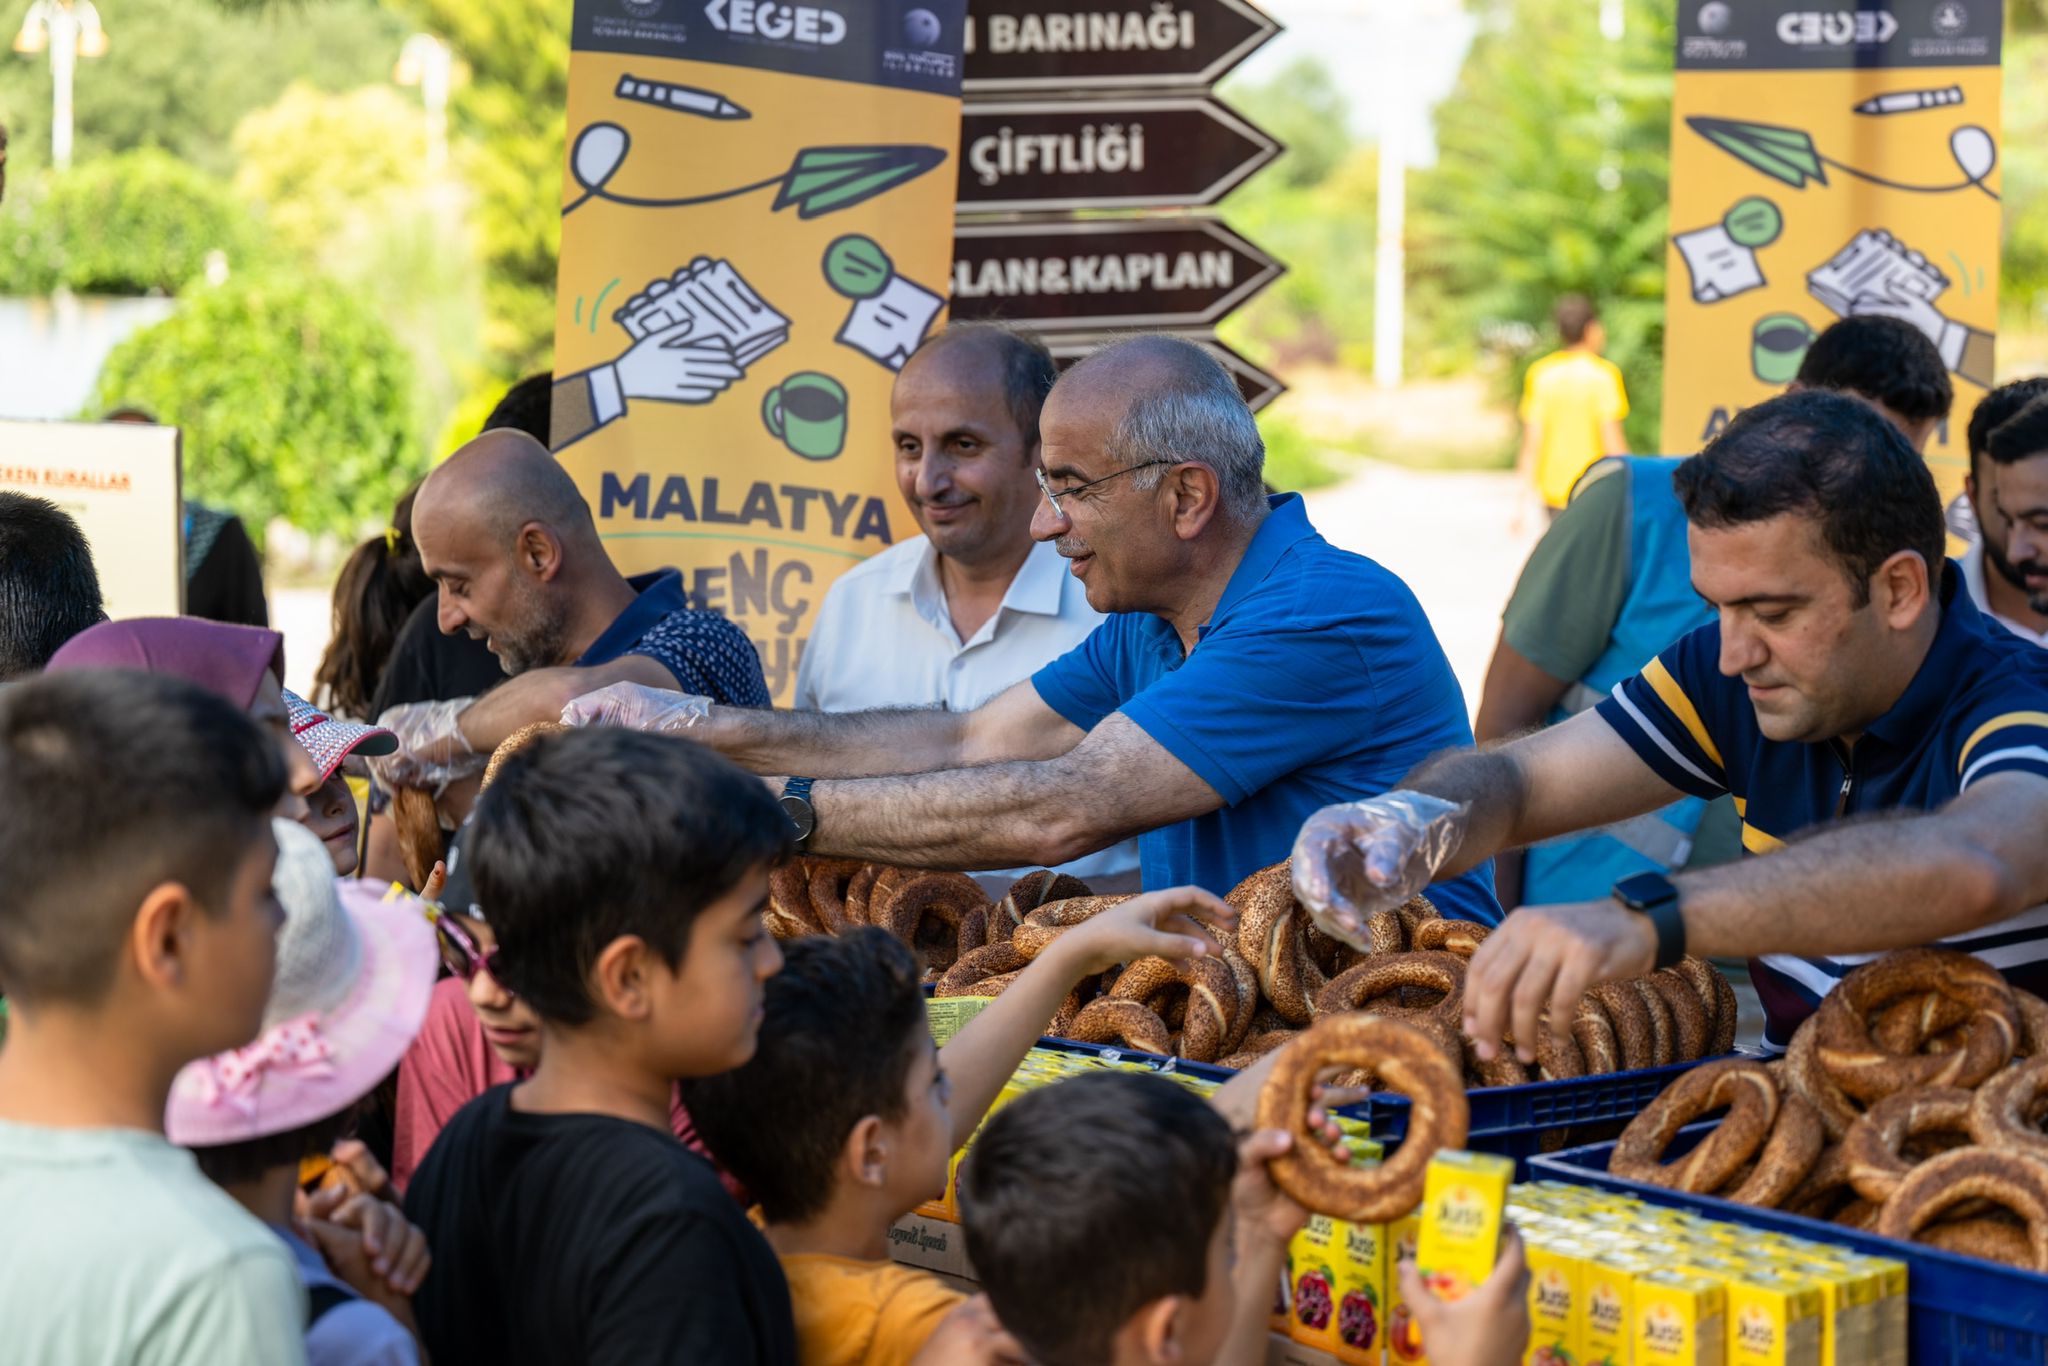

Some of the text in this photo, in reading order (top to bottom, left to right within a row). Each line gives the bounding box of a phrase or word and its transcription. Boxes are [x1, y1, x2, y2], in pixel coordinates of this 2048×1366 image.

[988, 3, 1194, 53] BARINAĞI
[969, 124, 1145, 186] ÇİFTLİĞİ
[600, 471, 893, 545] MALATYA
[689, 548, 814, 634] ENÇ
